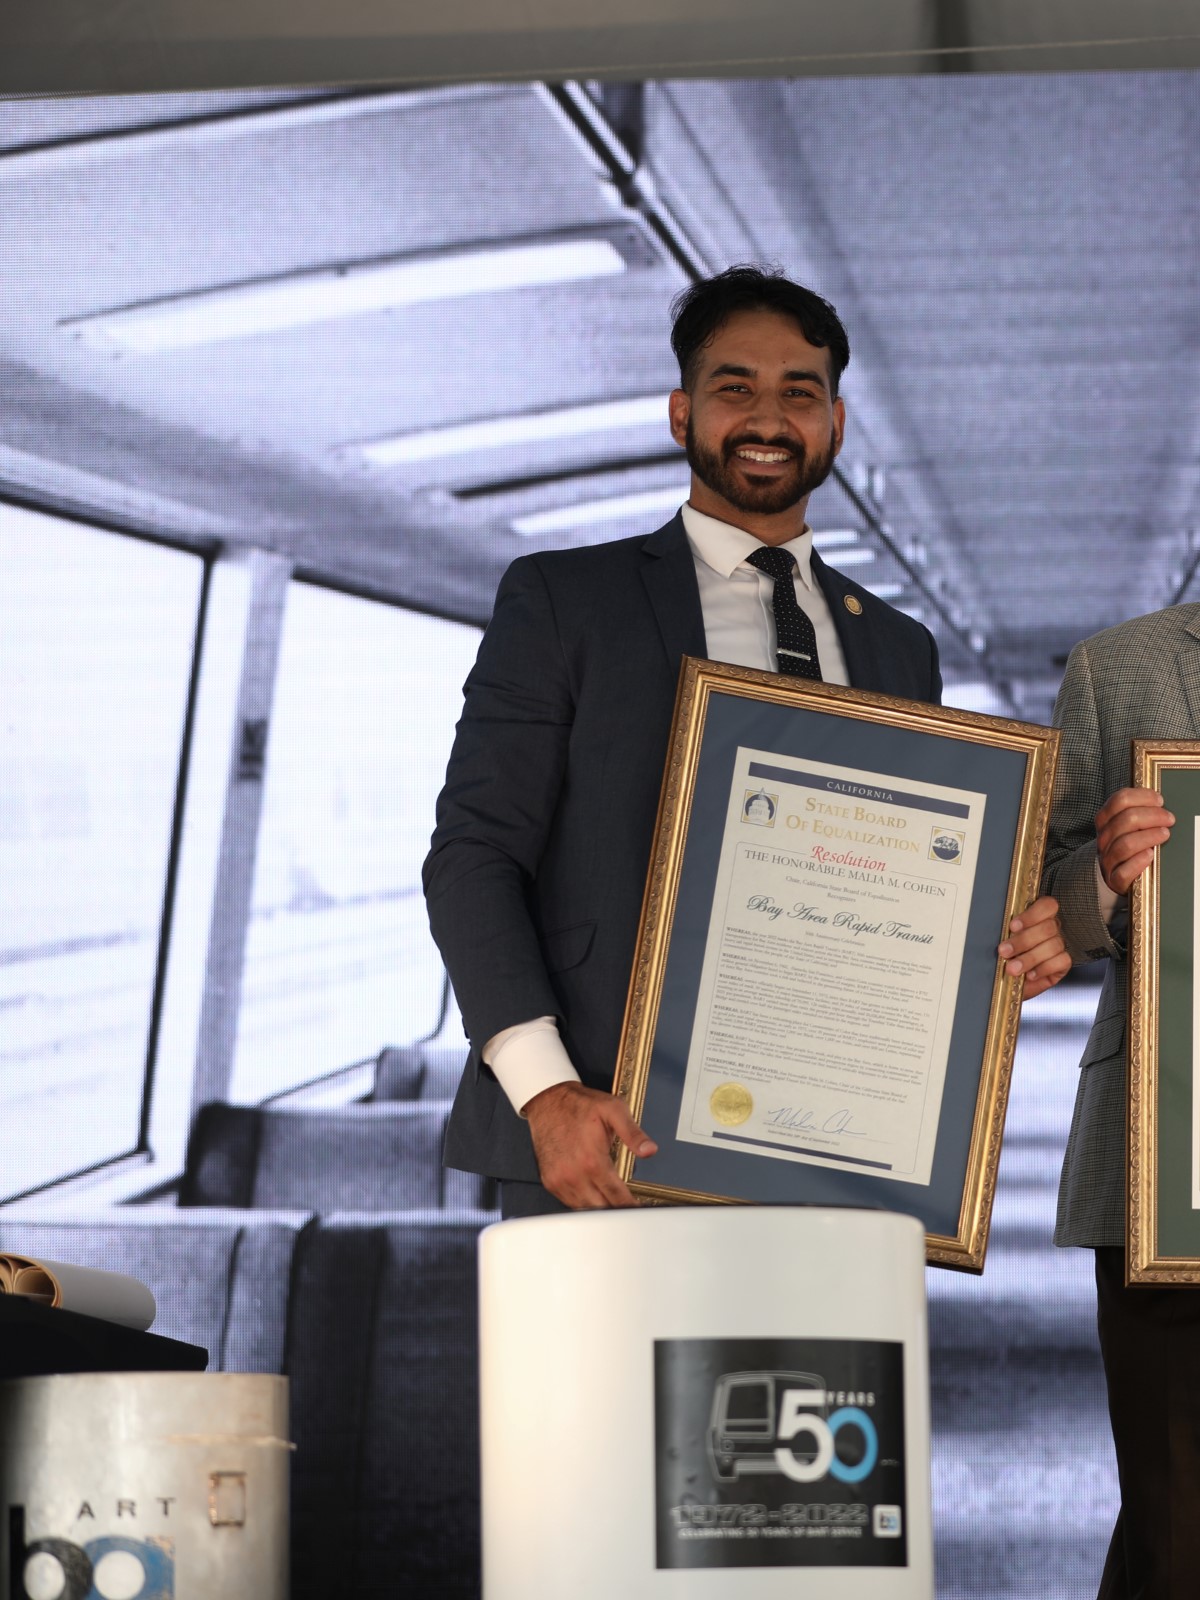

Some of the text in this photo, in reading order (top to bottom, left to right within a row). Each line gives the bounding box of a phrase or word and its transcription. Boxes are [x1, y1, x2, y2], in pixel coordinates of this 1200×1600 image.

[826, 781, 894, 801] CALIFORNIA
[805, 797, 907, 829] STATE BOARD
[812, 818, 920, 853] EQUALIZATION
[744, 849, 946, 897] THE HONORABLE MALIA M. COHEN
[810, 845, 887, 872] Resolution
[746, 894, 934, 945] Bay Area Rapid Transit
[827, 1391, 875, 1406] YEARS
[774, 1388, 879, 1484] 50
[670, 1503, 869, 1527] 1972-2022
